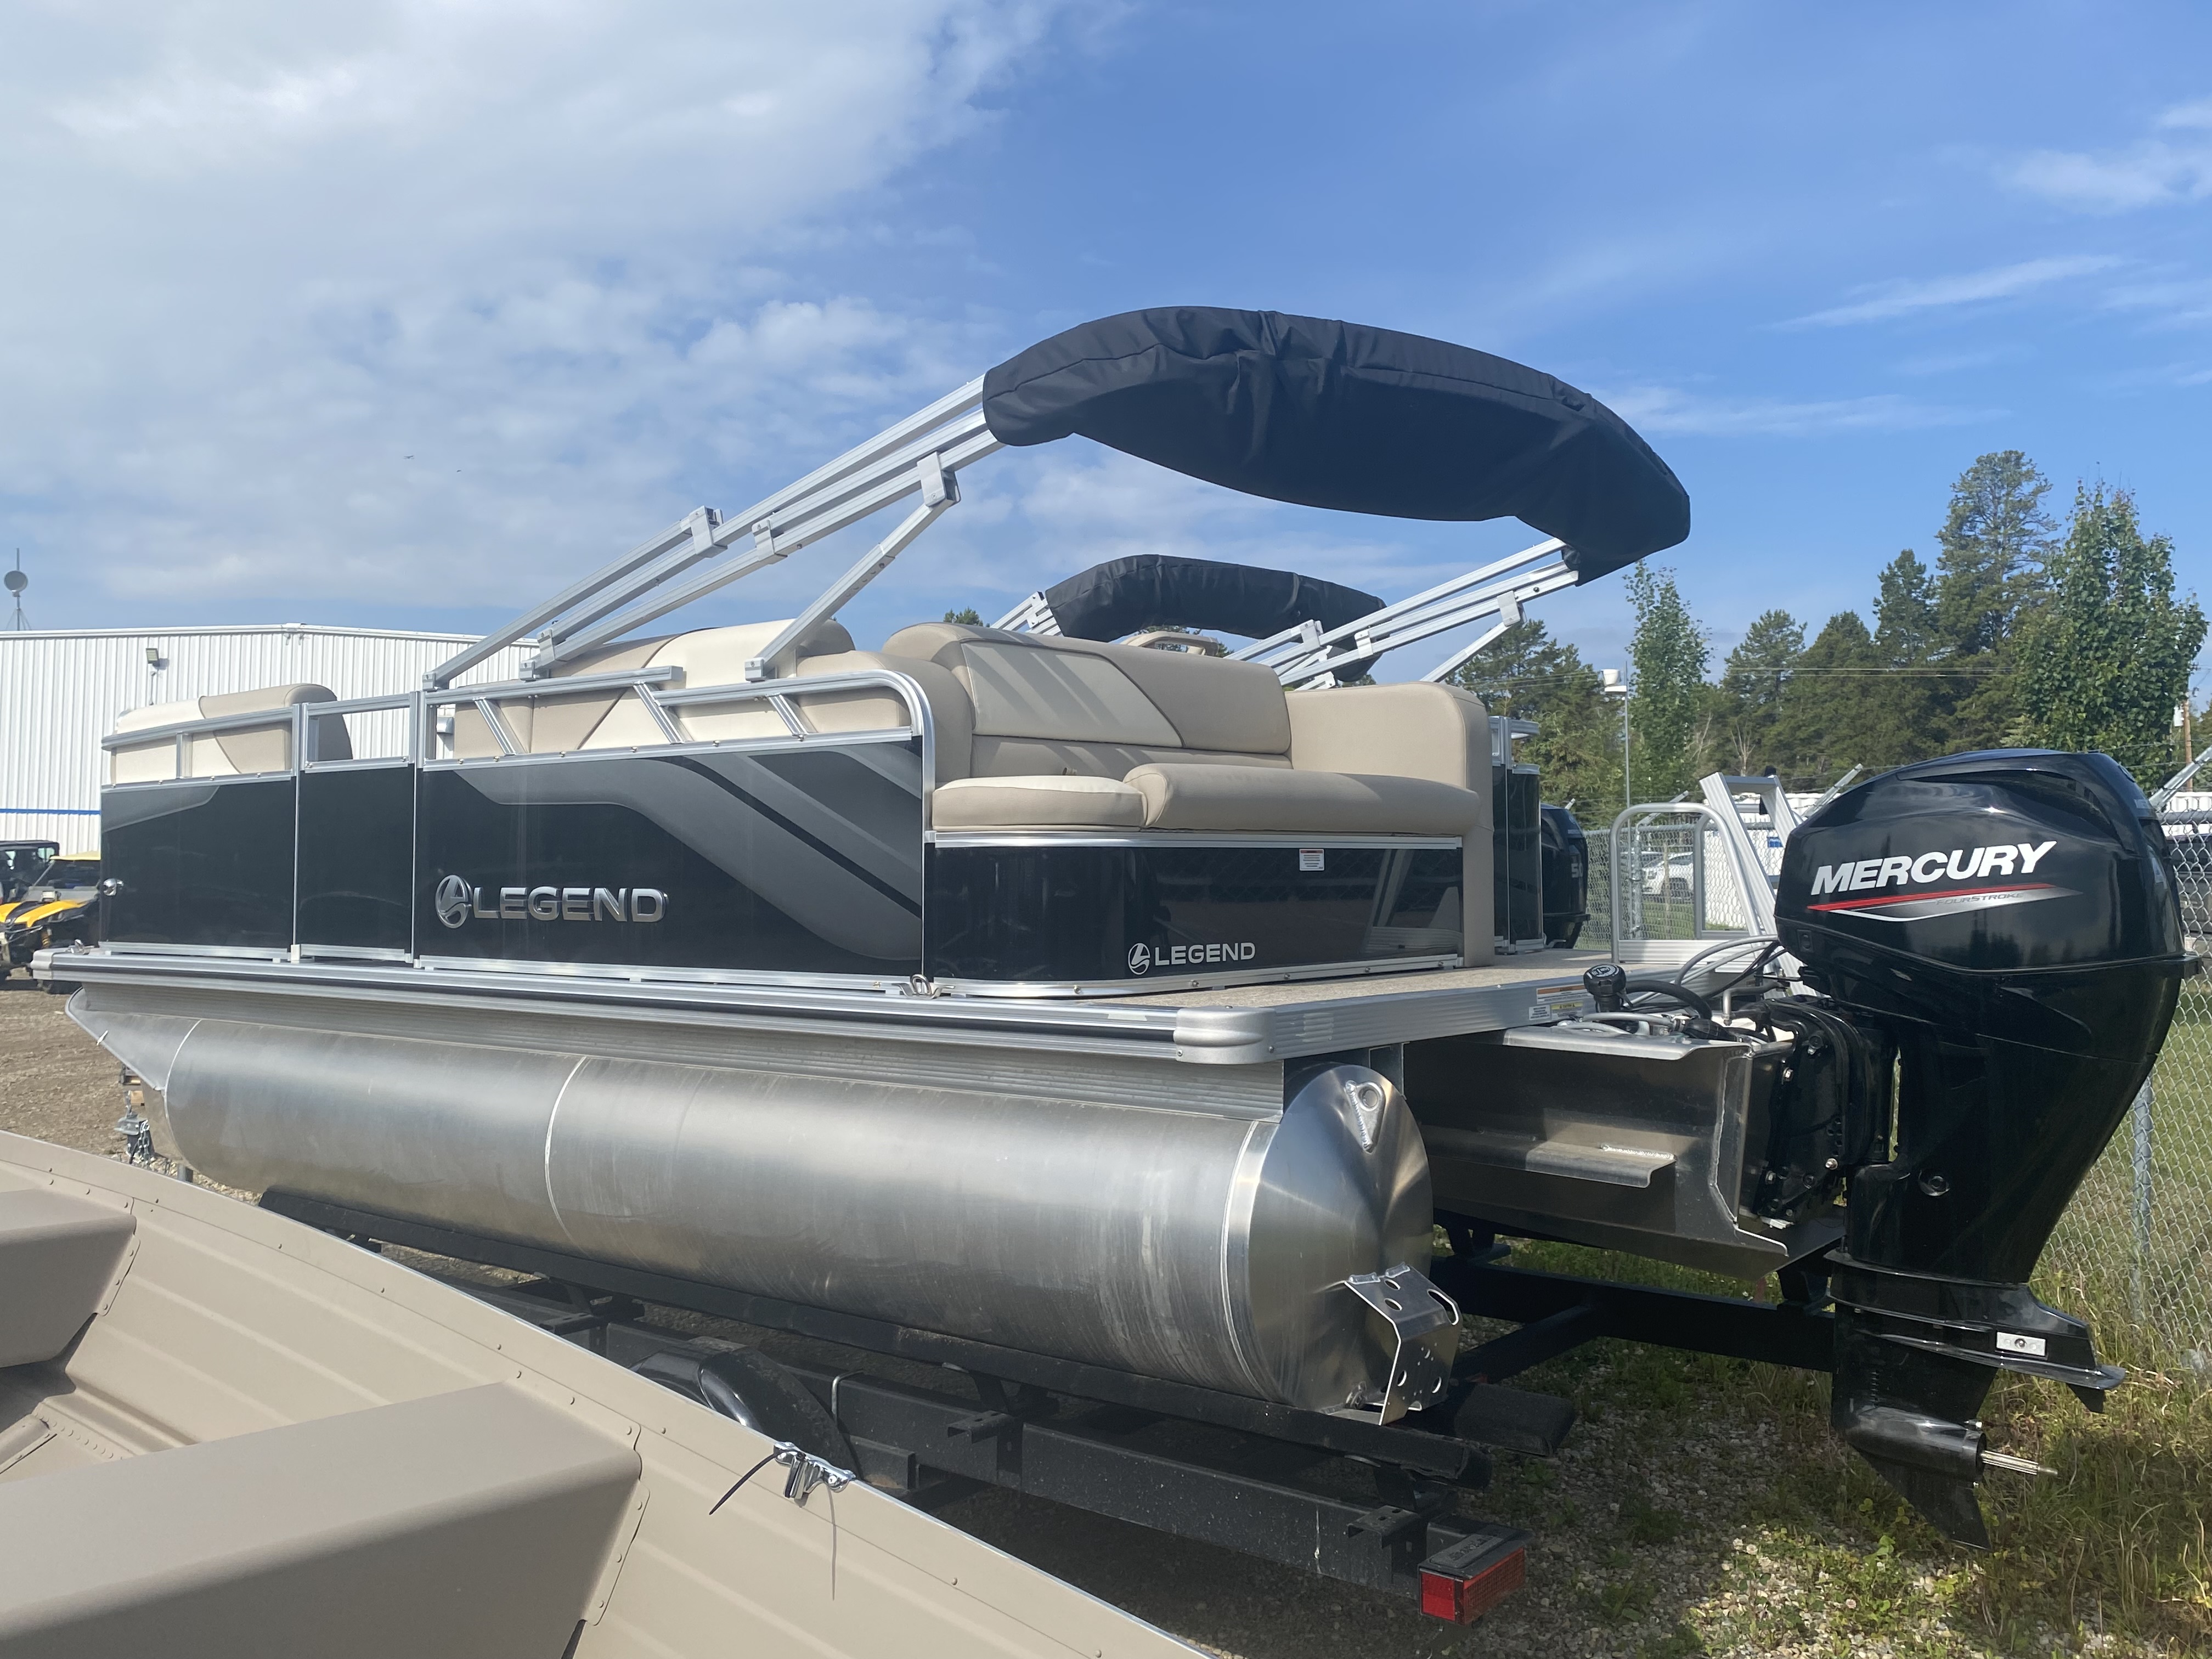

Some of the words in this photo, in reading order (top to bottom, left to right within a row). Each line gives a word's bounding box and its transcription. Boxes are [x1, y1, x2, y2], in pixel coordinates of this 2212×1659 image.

[1811, 840, 2058, 895] MERCURY
[473, 886, 668, 922] LEGEND
[1936, 892, 2024, 905] FOURSTROKE
[1155, 942, 1256, 966] LEGEND
